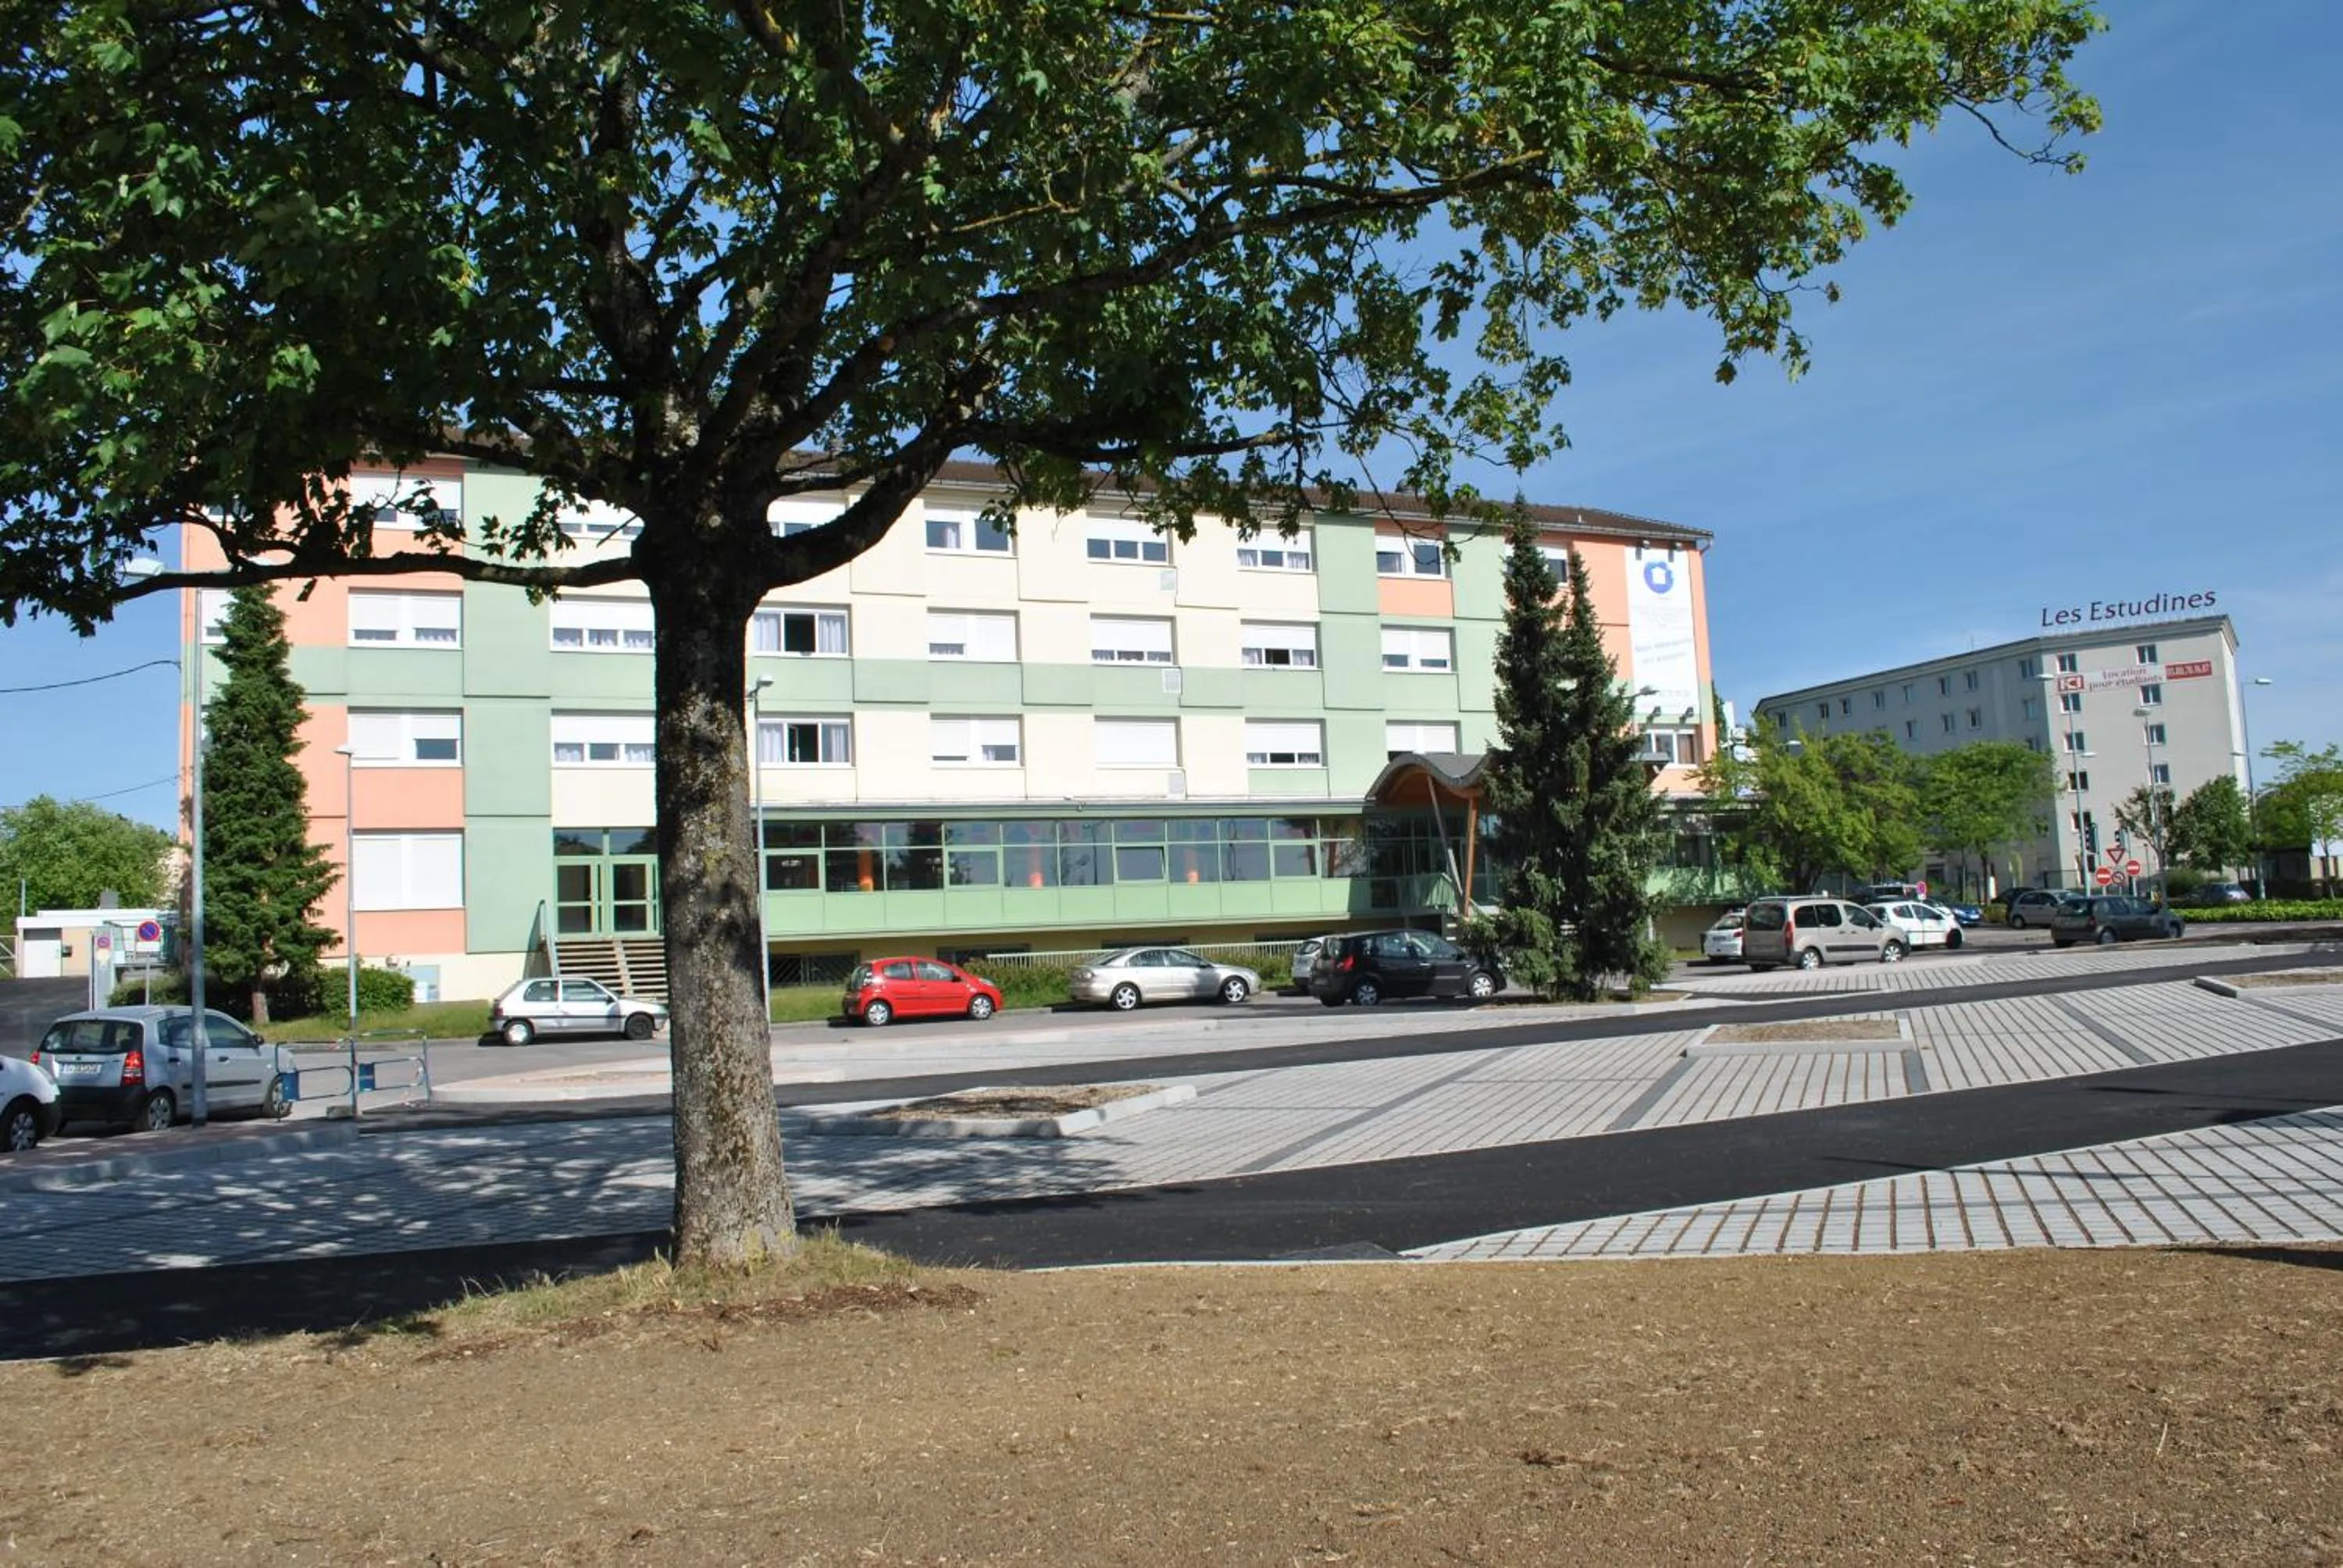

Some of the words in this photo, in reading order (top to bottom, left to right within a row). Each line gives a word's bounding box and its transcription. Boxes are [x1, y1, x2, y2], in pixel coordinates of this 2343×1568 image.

[2042, 607, 2081, 627] Les
[2088, 590, 2216, 622] Estudines
[2102, 667, 2147, 679] Location
